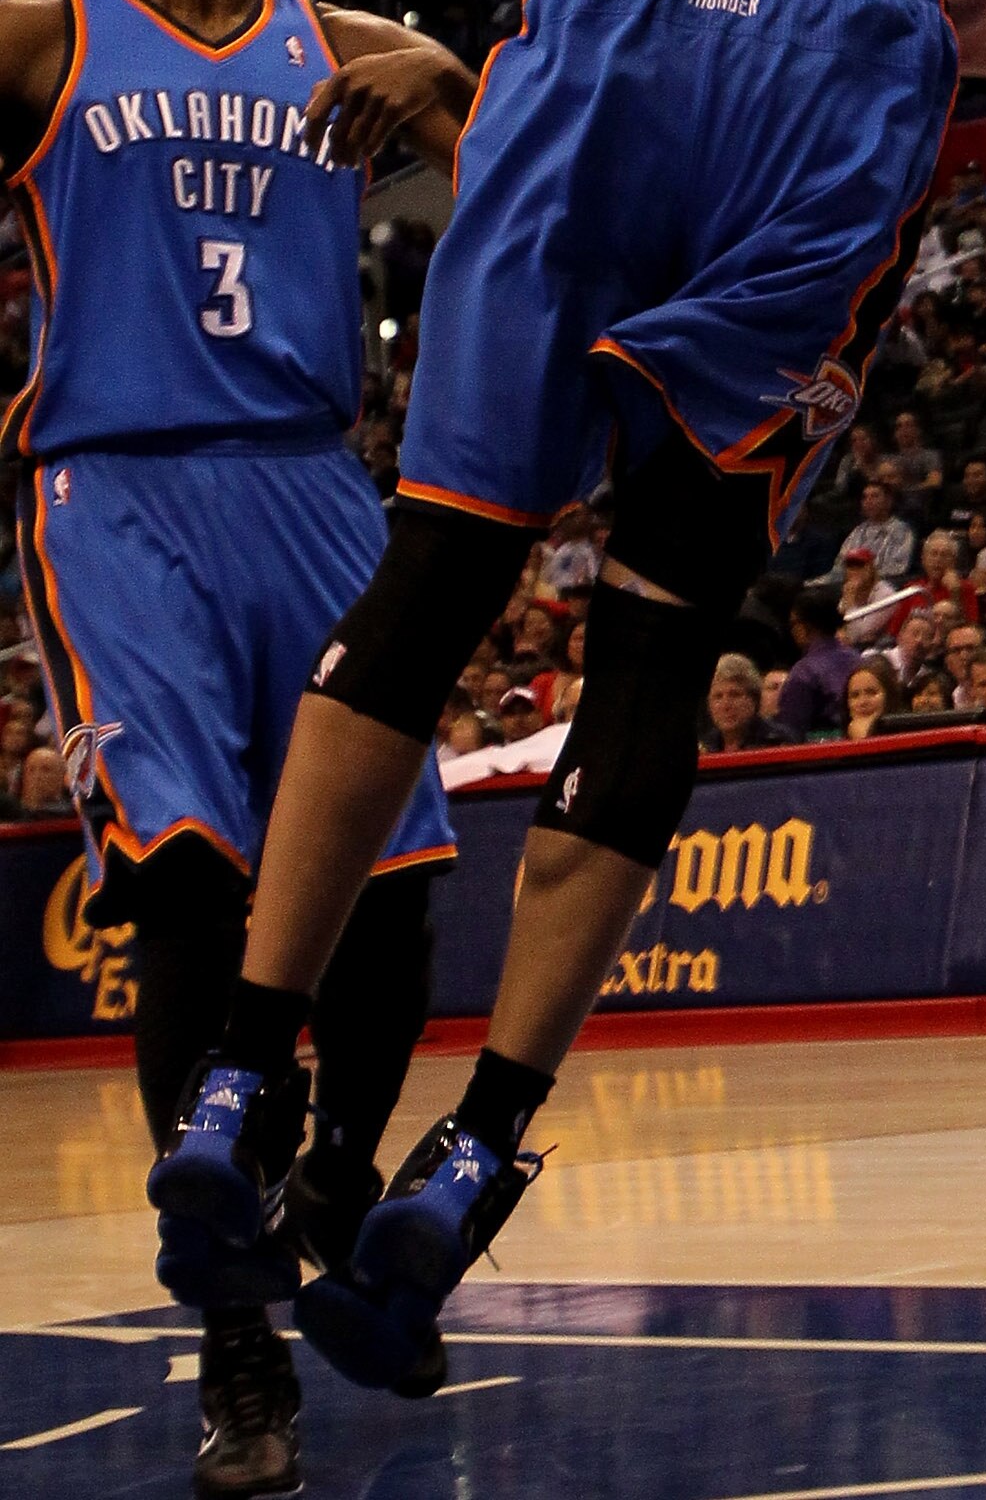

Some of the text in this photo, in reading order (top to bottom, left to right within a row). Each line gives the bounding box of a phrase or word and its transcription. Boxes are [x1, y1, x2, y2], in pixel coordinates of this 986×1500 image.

[172, 156, 274, 217] CITY
[200, 238, 253, 338] 3
[645, 816, 815, 915] ona
[599, 940, 721, 997] xtra
